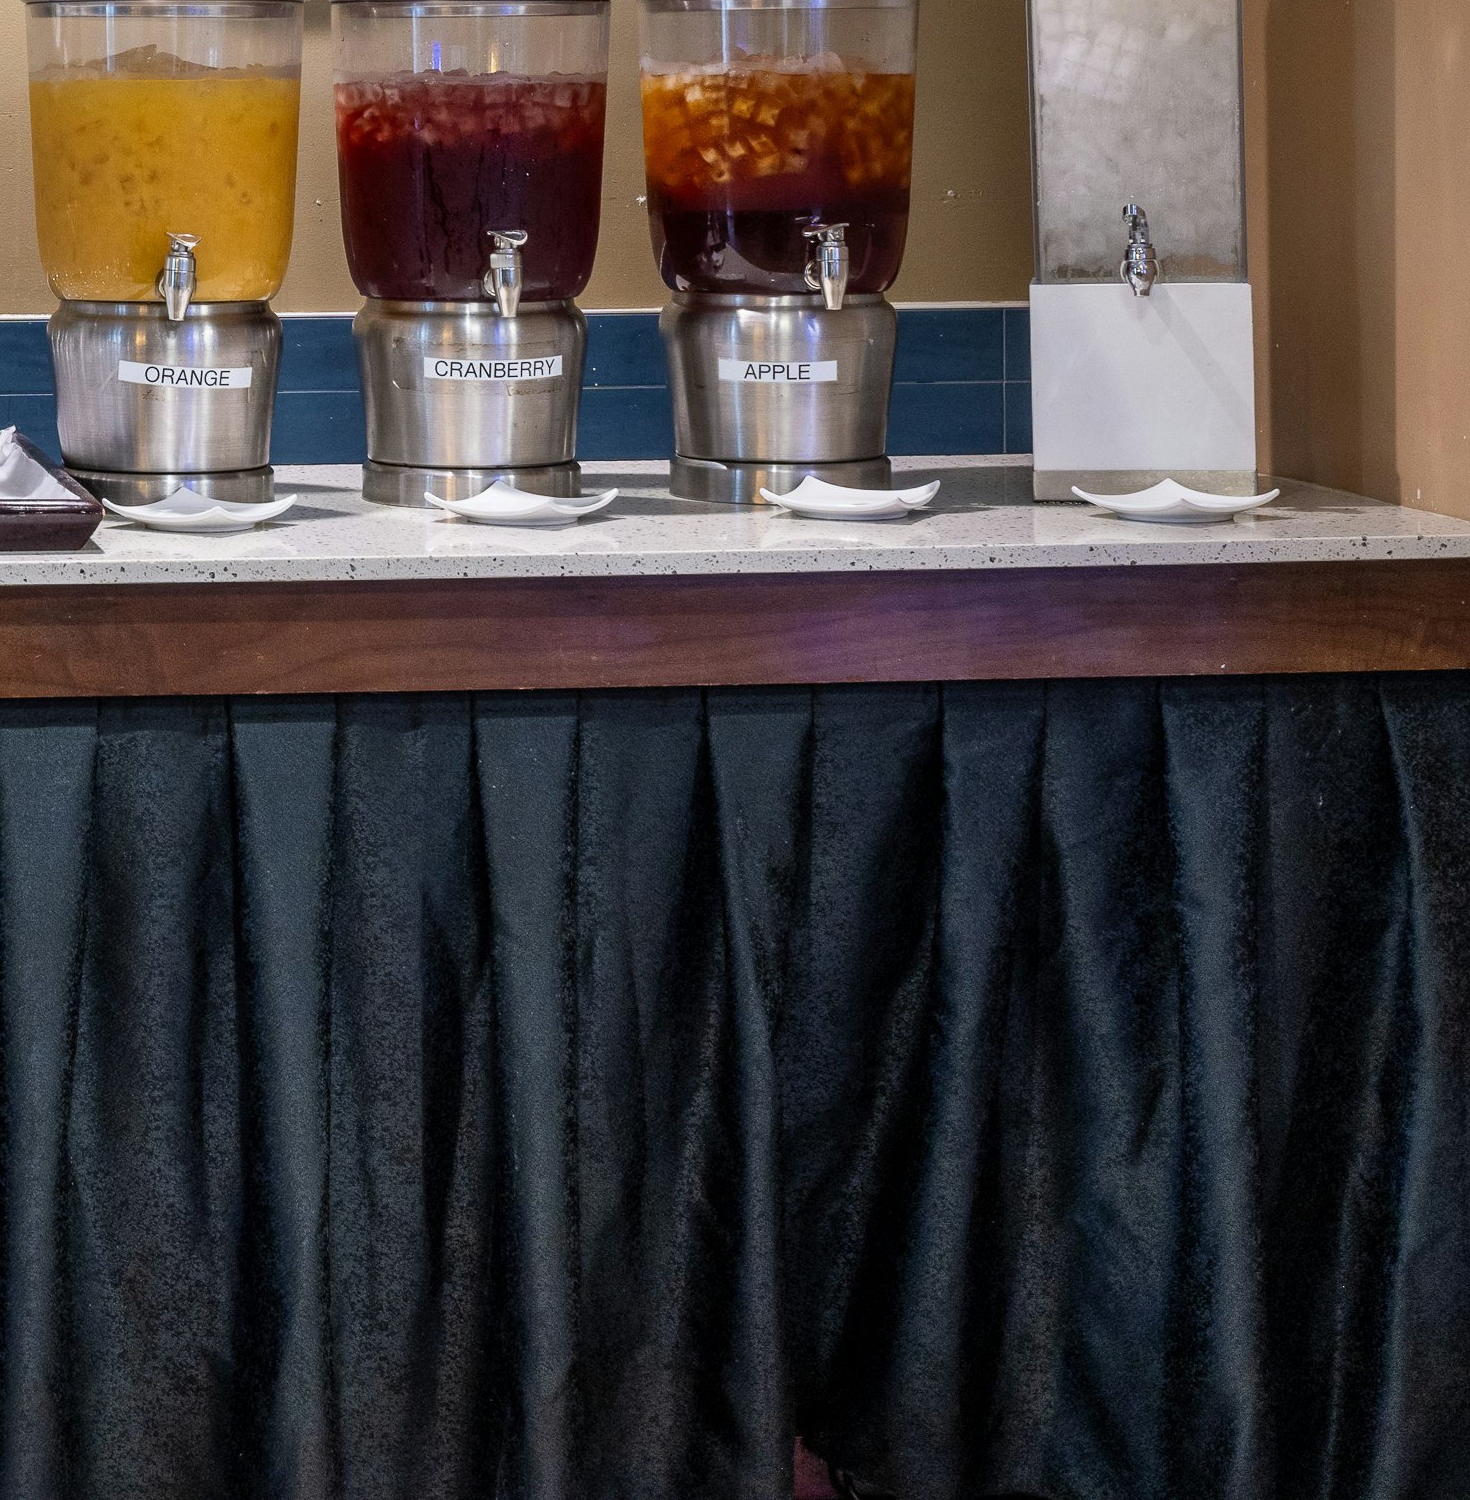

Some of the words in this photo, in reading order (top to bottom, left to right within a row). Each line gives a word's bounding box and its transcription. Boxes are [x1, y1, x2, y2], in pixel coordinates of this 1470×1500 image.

[144, 365, 231, 387] ORANGE
[434, 358, 555, 379] CRANBERRY
[743, 363, 811, 380] APPLE
